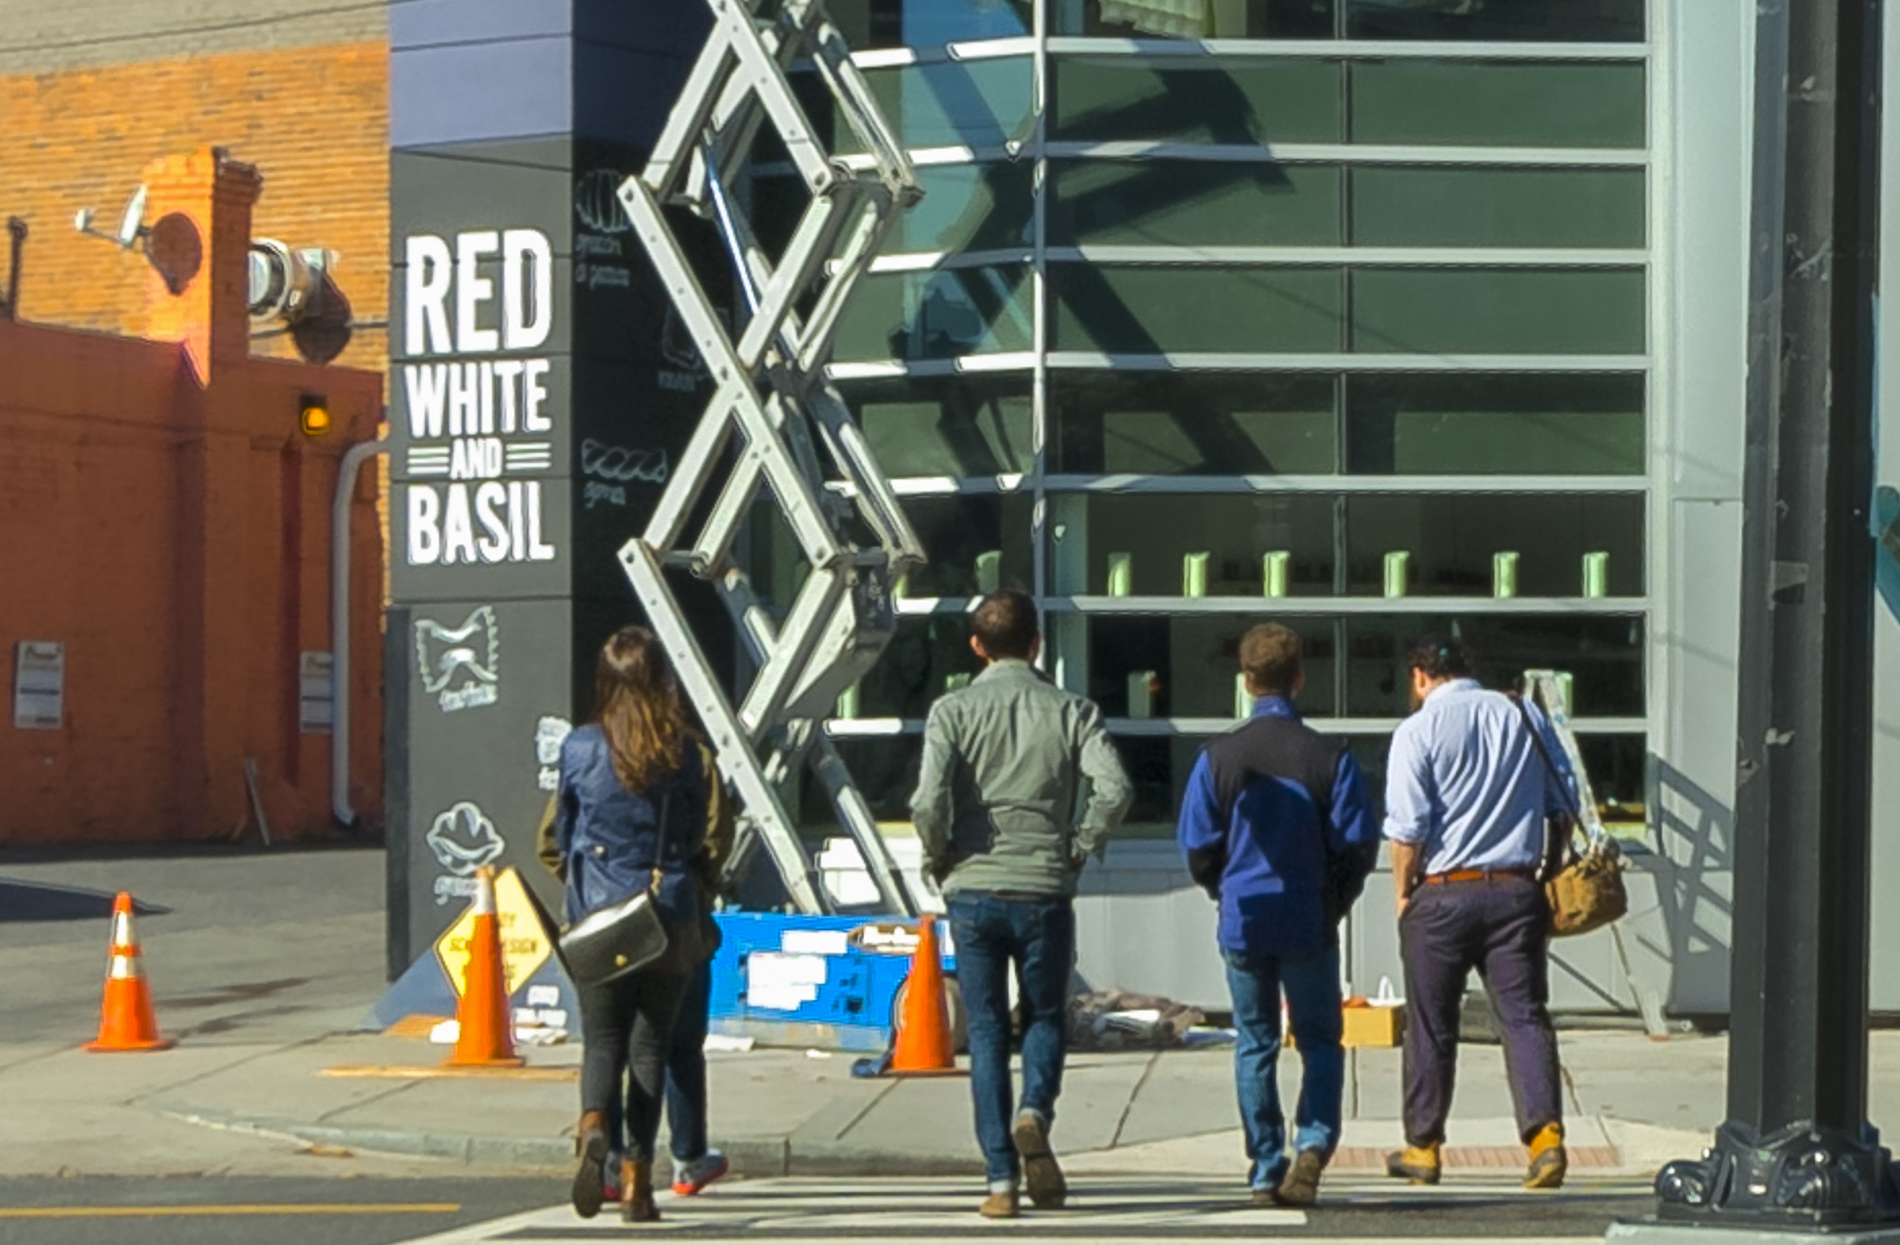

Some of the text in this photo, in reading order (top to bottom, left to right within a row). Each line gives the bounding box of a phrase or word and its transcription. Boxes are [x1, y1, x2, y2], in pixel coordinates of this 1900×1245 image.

[404, 227, 553, 356] RED
[404, 358, 552, 438] WHITE
[448, 437, 504, 479] AND
[406, 480, 556, 566] BASIL
